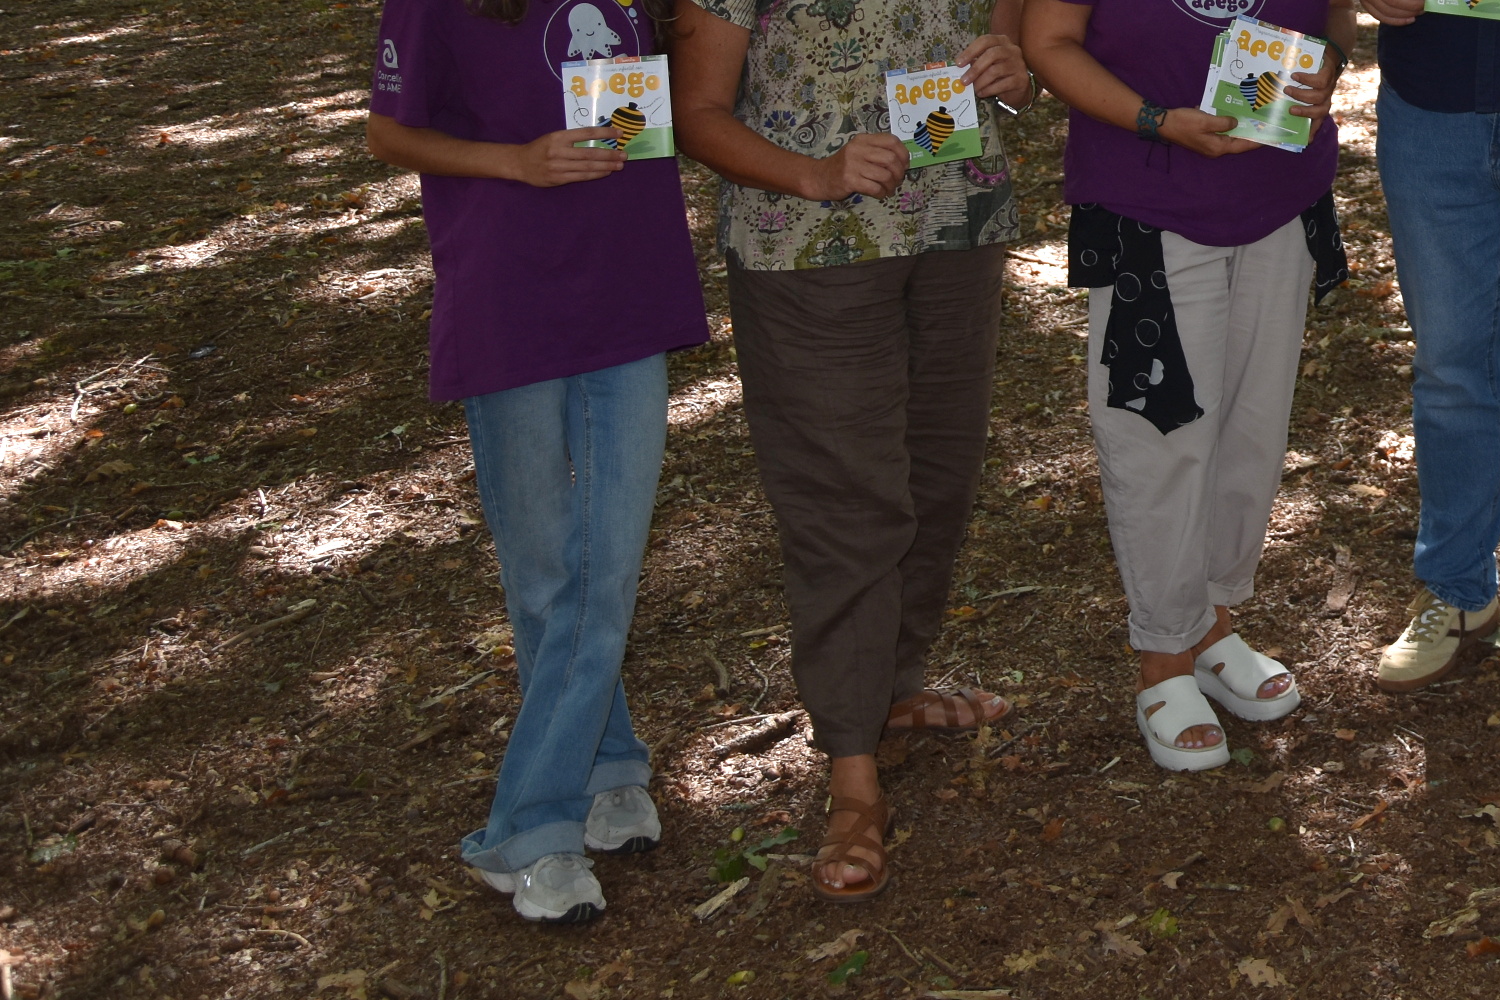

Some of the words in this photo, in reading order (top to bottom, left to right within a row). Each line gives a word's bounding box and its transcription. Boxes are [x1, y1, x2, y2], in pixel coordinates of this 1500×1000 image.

[1237, 30, 1313, 69] apego
[386, 82, 402, 94] AME
[571, 72, 661, 98] apego
[895, 77, 966, 105] apego
